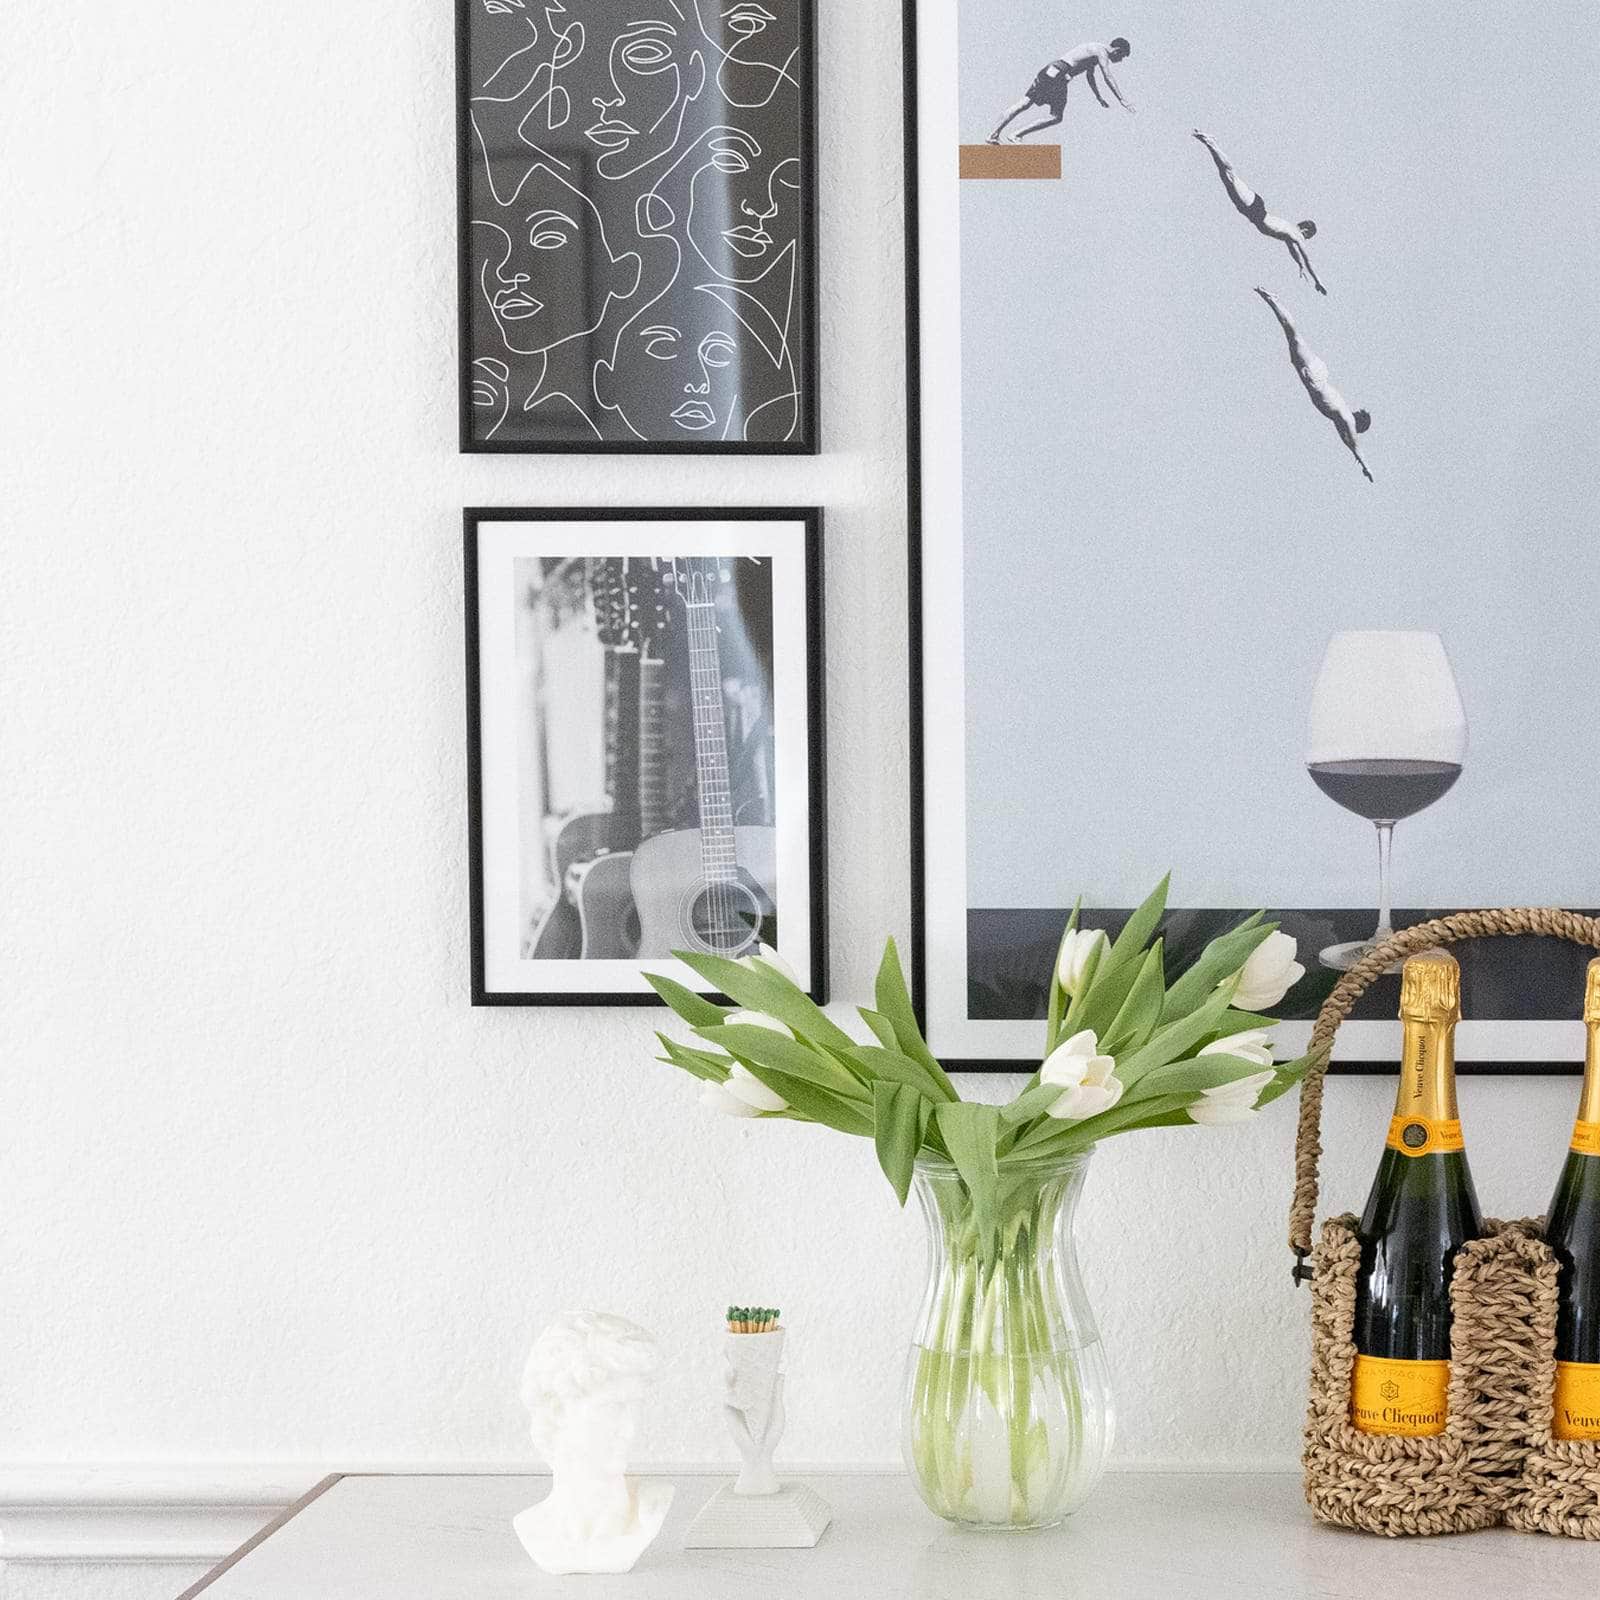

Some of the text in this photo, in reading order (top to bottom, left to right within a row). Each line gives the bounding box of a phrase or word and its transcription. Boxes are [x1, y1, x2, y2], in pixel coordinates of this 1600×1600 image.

[1413, 1035, 1427, 1099] Veuve Clicquot
[1382, 1406, 1440, 1427] Clicquot
